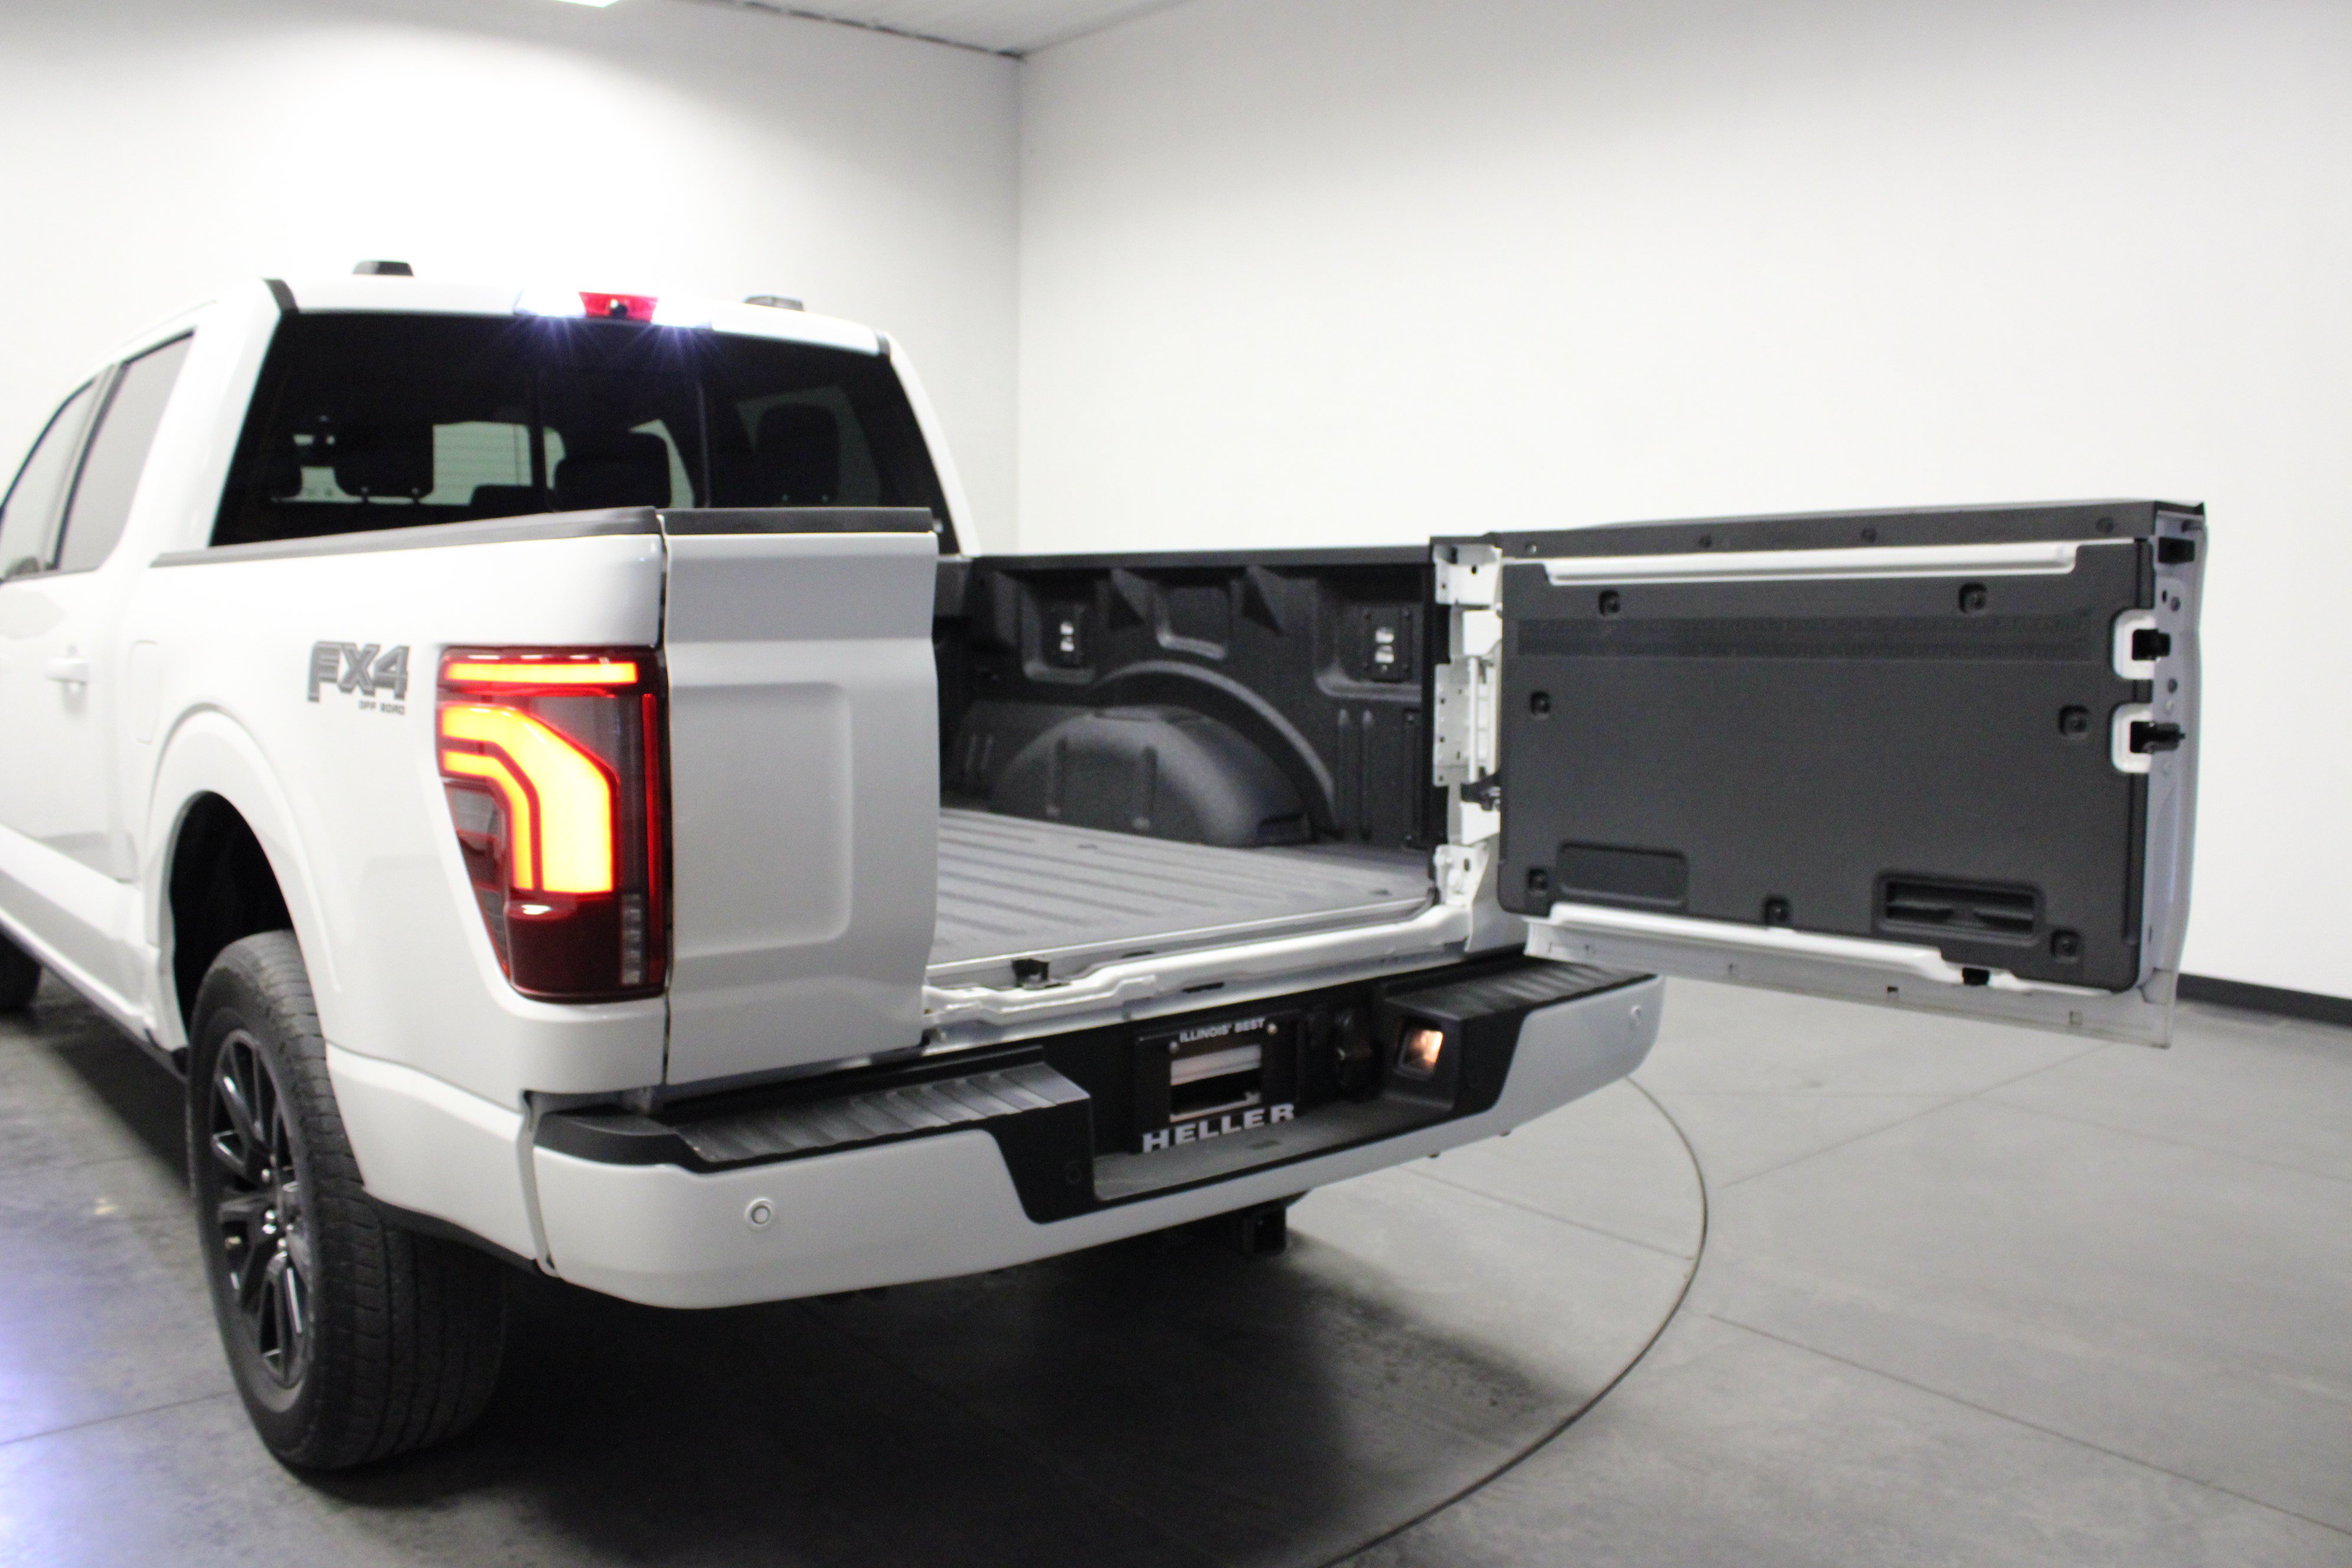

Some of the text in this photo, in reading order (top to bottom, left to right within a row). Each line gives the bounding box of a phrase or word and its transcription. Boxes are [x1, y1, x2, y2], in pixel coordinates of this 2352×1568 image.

[308, 642, 410, 703] FX4
[1234, 1017, 1266, 1033] BEST
[1143, 1103, 1295, 1154] HELLER
